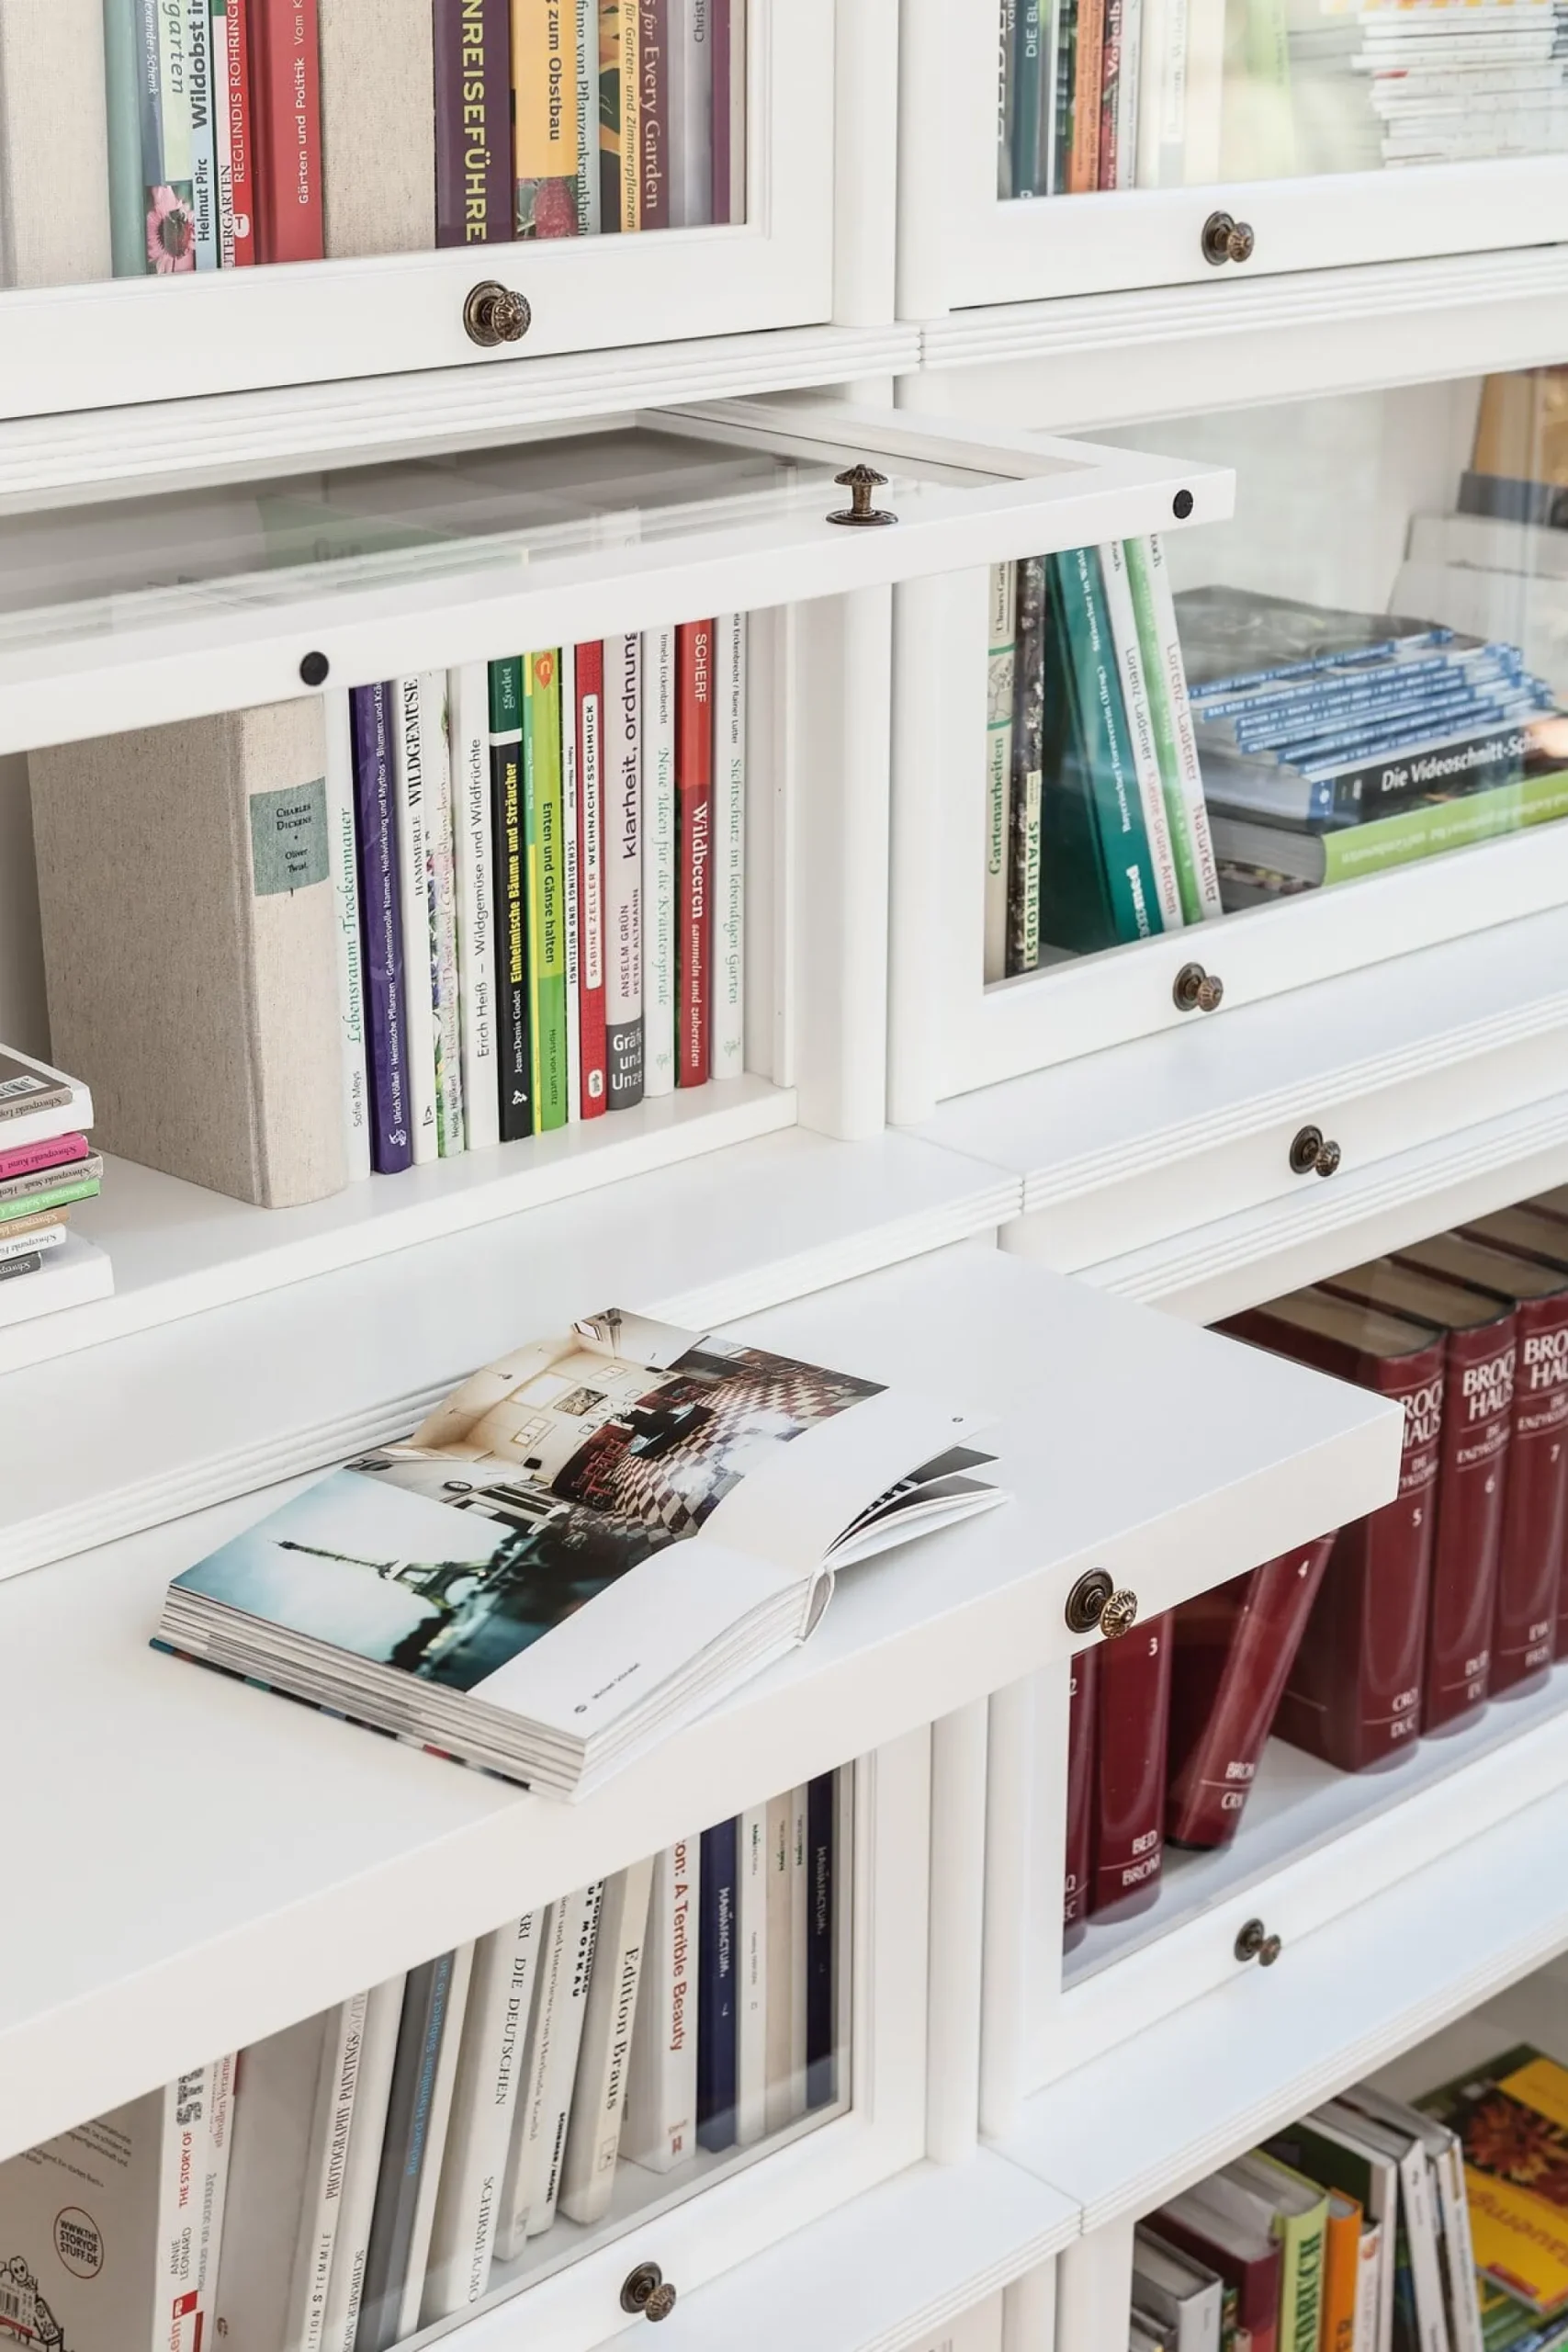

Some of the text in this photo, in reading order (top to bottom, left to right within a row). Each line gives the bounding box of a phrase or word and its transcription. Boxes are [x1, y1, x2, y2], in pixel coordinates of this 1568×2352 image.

[163, 0, 185, 93] garten
[547, 9, 562, 141] zum Obstbau
[1025, 29, 1037, 58] DIE
[188, 21, 210, 242] Helmut Pirc Wildobst
[231, 92, 244, 183] REGLINDIS
[294, 14, 308, 204] Gärten und Politik Vom
[624, 3, 637, 229] für Garten- und Zimmerpflanzen
[640, 11, 661, 209] for Every Garden
[660, 634, 669, 663] Irmela
[375, 702, 383, 719] und
[375, 721, 385, 755] Blumen
[377, 763, 388, 797] Mythos
[658, 747, 671, 787] Neue
[1381, 769, 1409, 793] Die
[276, 802, 311, 819] CHARLES
[276, 815, 312, 831] DICKENS
[378, 798, 388, 816] und
[622, 746, 637, 860] klarheit,
[988, 737, 1004, 875] Gartenarbeiten
[336, 808, 357, 932] Trockenmauer
[378, 818, 391, 872] Heilwirkung
[585, 705, 598, 977] SABINE ZELLER WEIHNACHTSSCHMUCK
[691, 633, 708, 1067] SCHERF Wildbeeren sammeln und zubereiten
[468, 739, 490, 1058] Erich Heiß Wildgemüse und Wildfrüchte
[543, 802, 556, 964] Enten und Gänse halten
[657, 869, 671, 890] die
[1026, 820, 1039, 964] SPALIEROBST
[382, 910, 395, 975] Geheimnisvolle
[504, 763, 524, 1073] Jean-Denis Godet Einheimische Bäume und Sträucher
[568, 907, 576, 926] UND
[620, 905, 630, 998] ANSELM GRÜN
[343, 941, 362, 1043] Lebensraum
[389, 982, 399, 1018] Pflanzen
[389, 1021, 400, 1064] Heimische
[613, 1027, 642, 1051] Gräf
[354, 1098, 363, 1127] Sofie
[392, 1098, 402, 1124] Ulrich
[1412, 1508, 1423, 1528] 5
[1484, 1474, 1495, 1494] 6
[1148, 1637, 1158, 1657] 3
[673, 1883, 689, 1900] A
[571, 1920, 591, 1998] MOSKAU
[672, 1901, 689, 1977] Terrible
[495, 1958, 526, 2106] DIE DEUTSCHEN
[606, 1947, 640, 2110] Edition Braus
[670, 1982, 687, 2052] Beauty
[338, 2033, 361, 2101] PAINTINGS
[406, 2120, 424, 2176] Richard
[424, 1998, 443, 2052] Subject
[435, 1981, 445, 1996] to
[178, 2130, 193, 2209] THE STORY OF
[325, 2104, 353, 2199] PHOTOGRAPHY
[170, 2239, 181, 2276] ANNIE
[180, 2226, 192, 2281] LEONARD
[312, 2233, 332, 2302] STEMMLE
